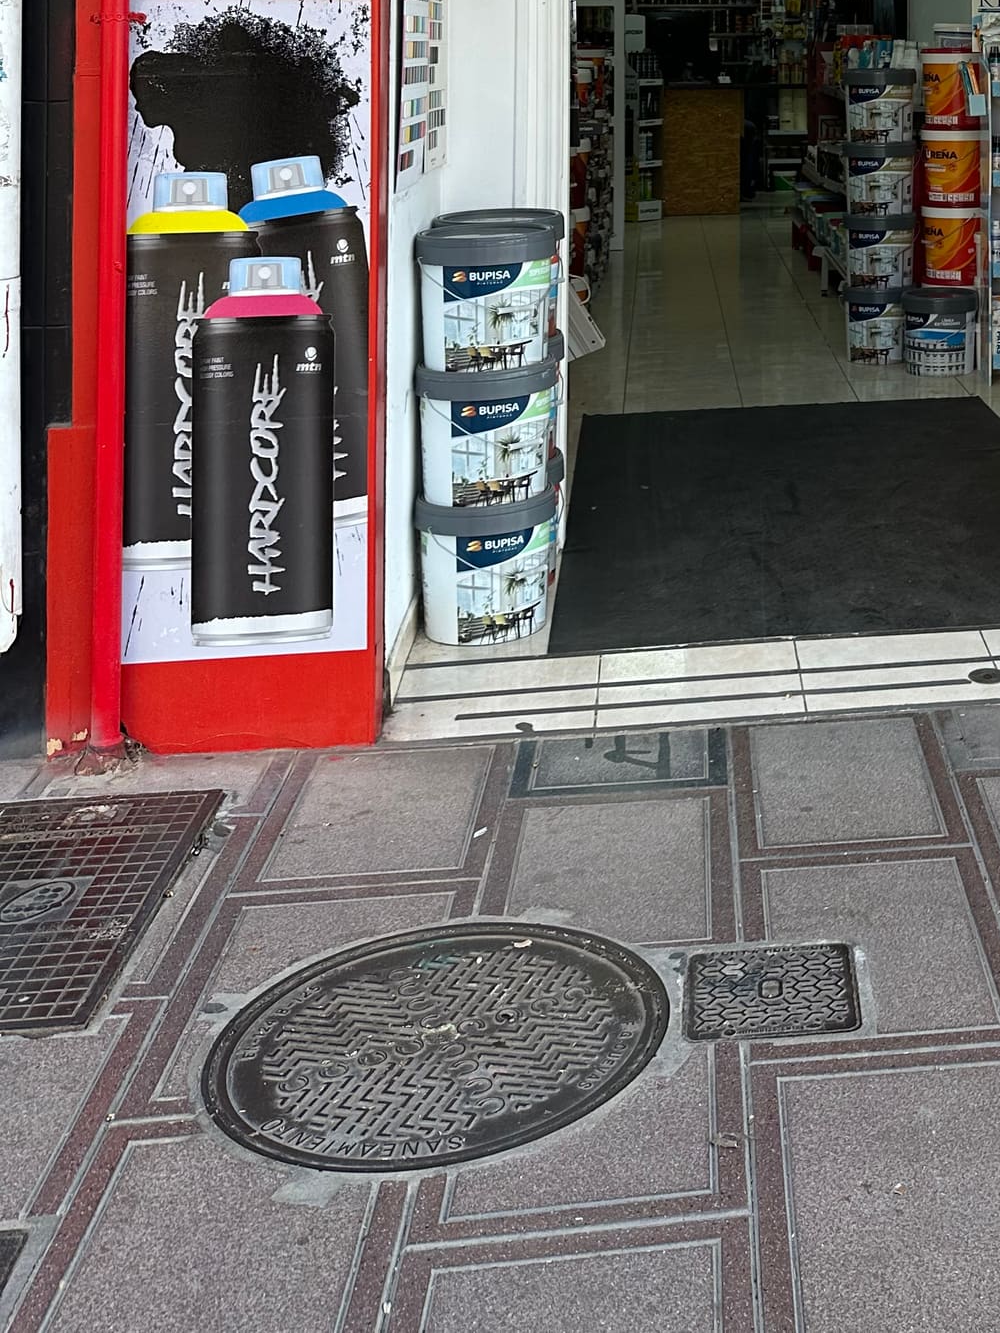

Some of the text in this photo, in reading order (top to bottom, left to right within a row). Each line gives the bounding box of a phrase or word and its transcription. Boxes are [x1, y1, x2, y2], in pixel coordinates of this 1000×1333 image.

[331, 255, 354, 264] mtn
[469, 270, 511, 282] BUPISA
[296, 363, 321, 372] mtn
[479, 403, 520, 416] BUPISA
[248, 354, 287, 595] HARDCORE
[484, 535, 524, 549] BUPISA
[259, 1117, 465, 1158] SANEAMIENTO
